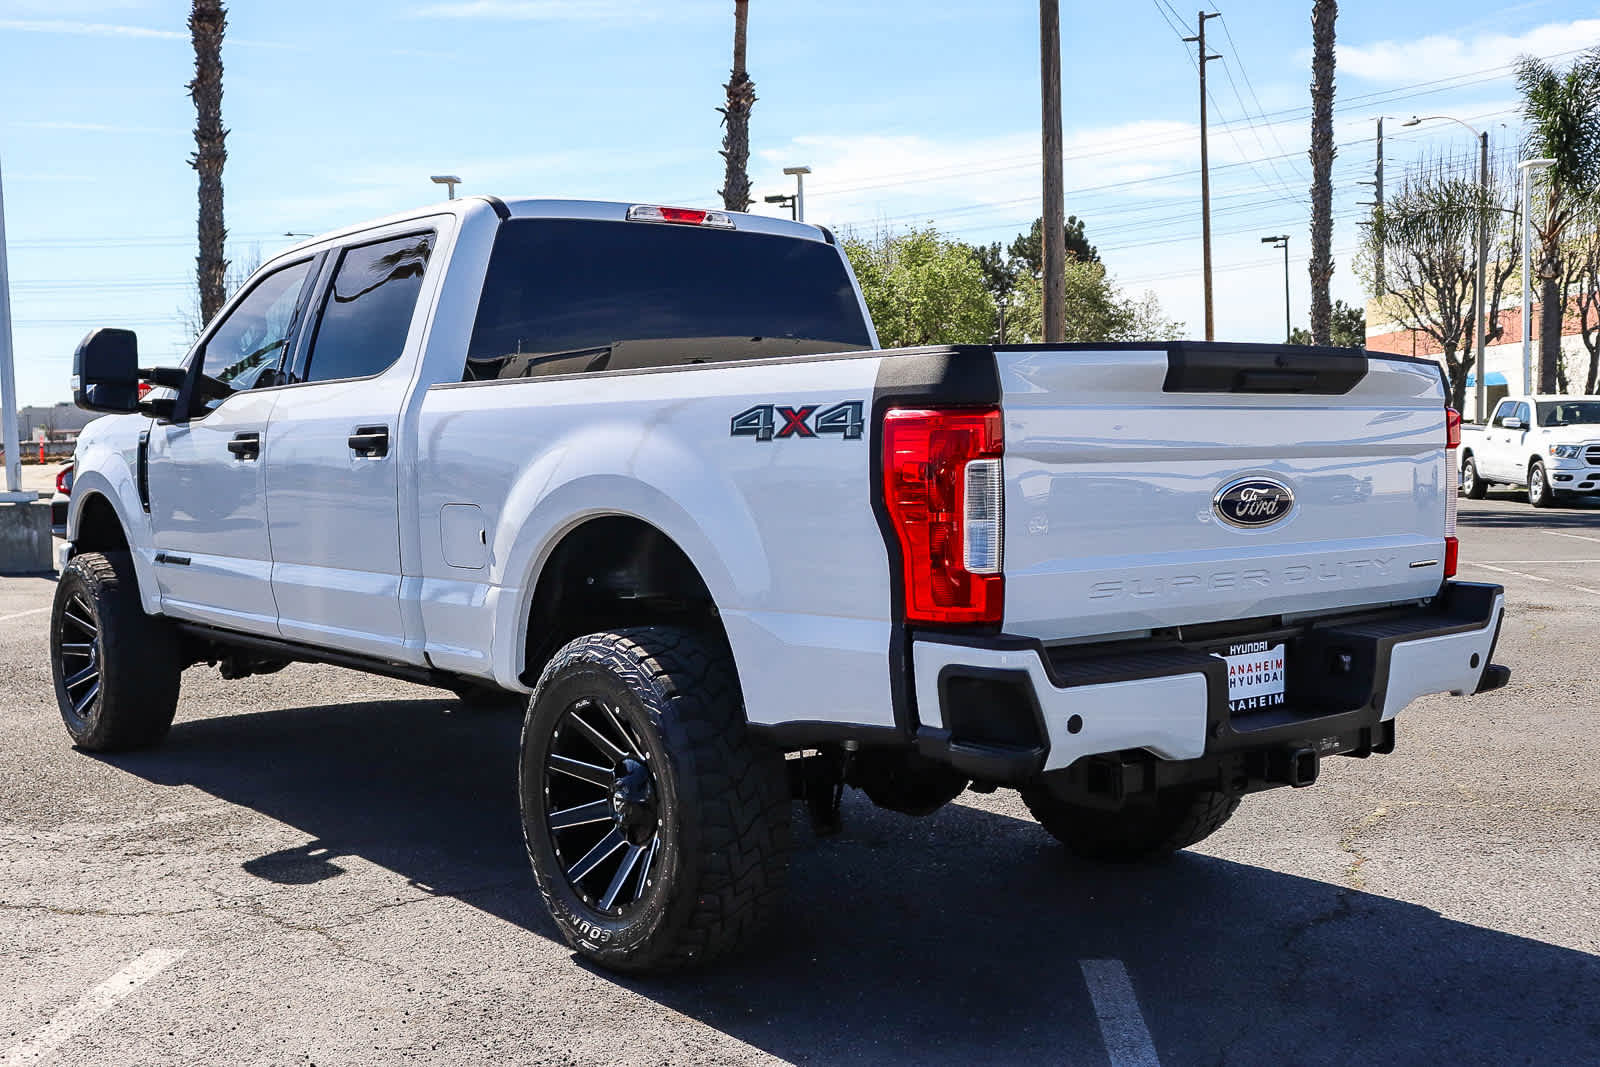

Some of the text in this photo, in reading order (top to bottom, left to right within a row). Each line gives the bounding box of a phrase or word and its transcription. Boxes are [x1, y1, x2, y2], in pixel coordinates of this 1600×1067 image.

[1236, 488, 1279, 516] Ford
[1088, 555, 1398, 599] SUPER DUTY
[1230, 641, 1268, 655] HYUNDAI
[1230, 659, 1283, 676] ANAHEIM
[1230, 671, 1283, 688] HYUNDAI
